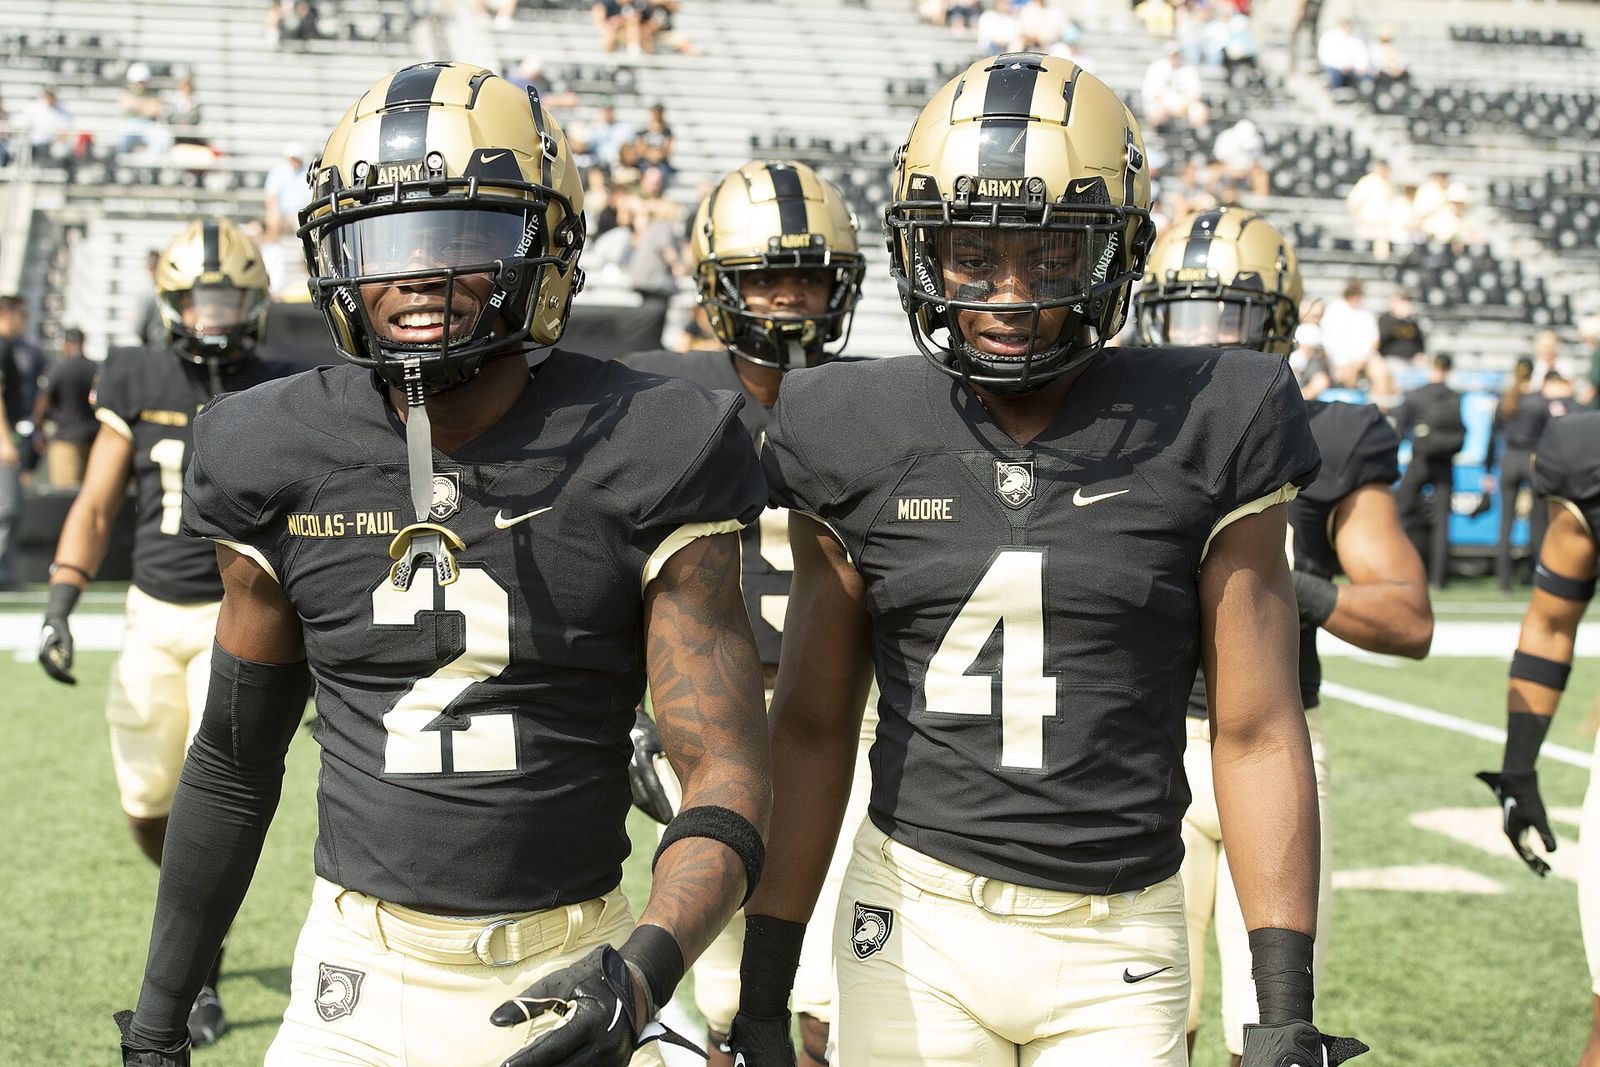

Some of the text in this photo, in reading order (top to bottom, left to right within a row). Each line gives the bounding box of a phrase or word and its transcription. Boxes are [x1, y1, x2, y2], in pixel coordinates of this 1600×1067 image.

[377, 164, 423, 185] ARMY
[977, 179, 1023, 198] ARMY
[514, 214, 540, 258] NIGHTS
[1092, 231, 1118, 280] KNIGHT
[915, 262, 946, 313] KNIGHS
[287, 511, 400, 537] NICOLAS-PAUL
[898, 498, 953, 520] MOORE
[371, 567, 518, 774] 2
[924, 551, 1057, 769] 4
